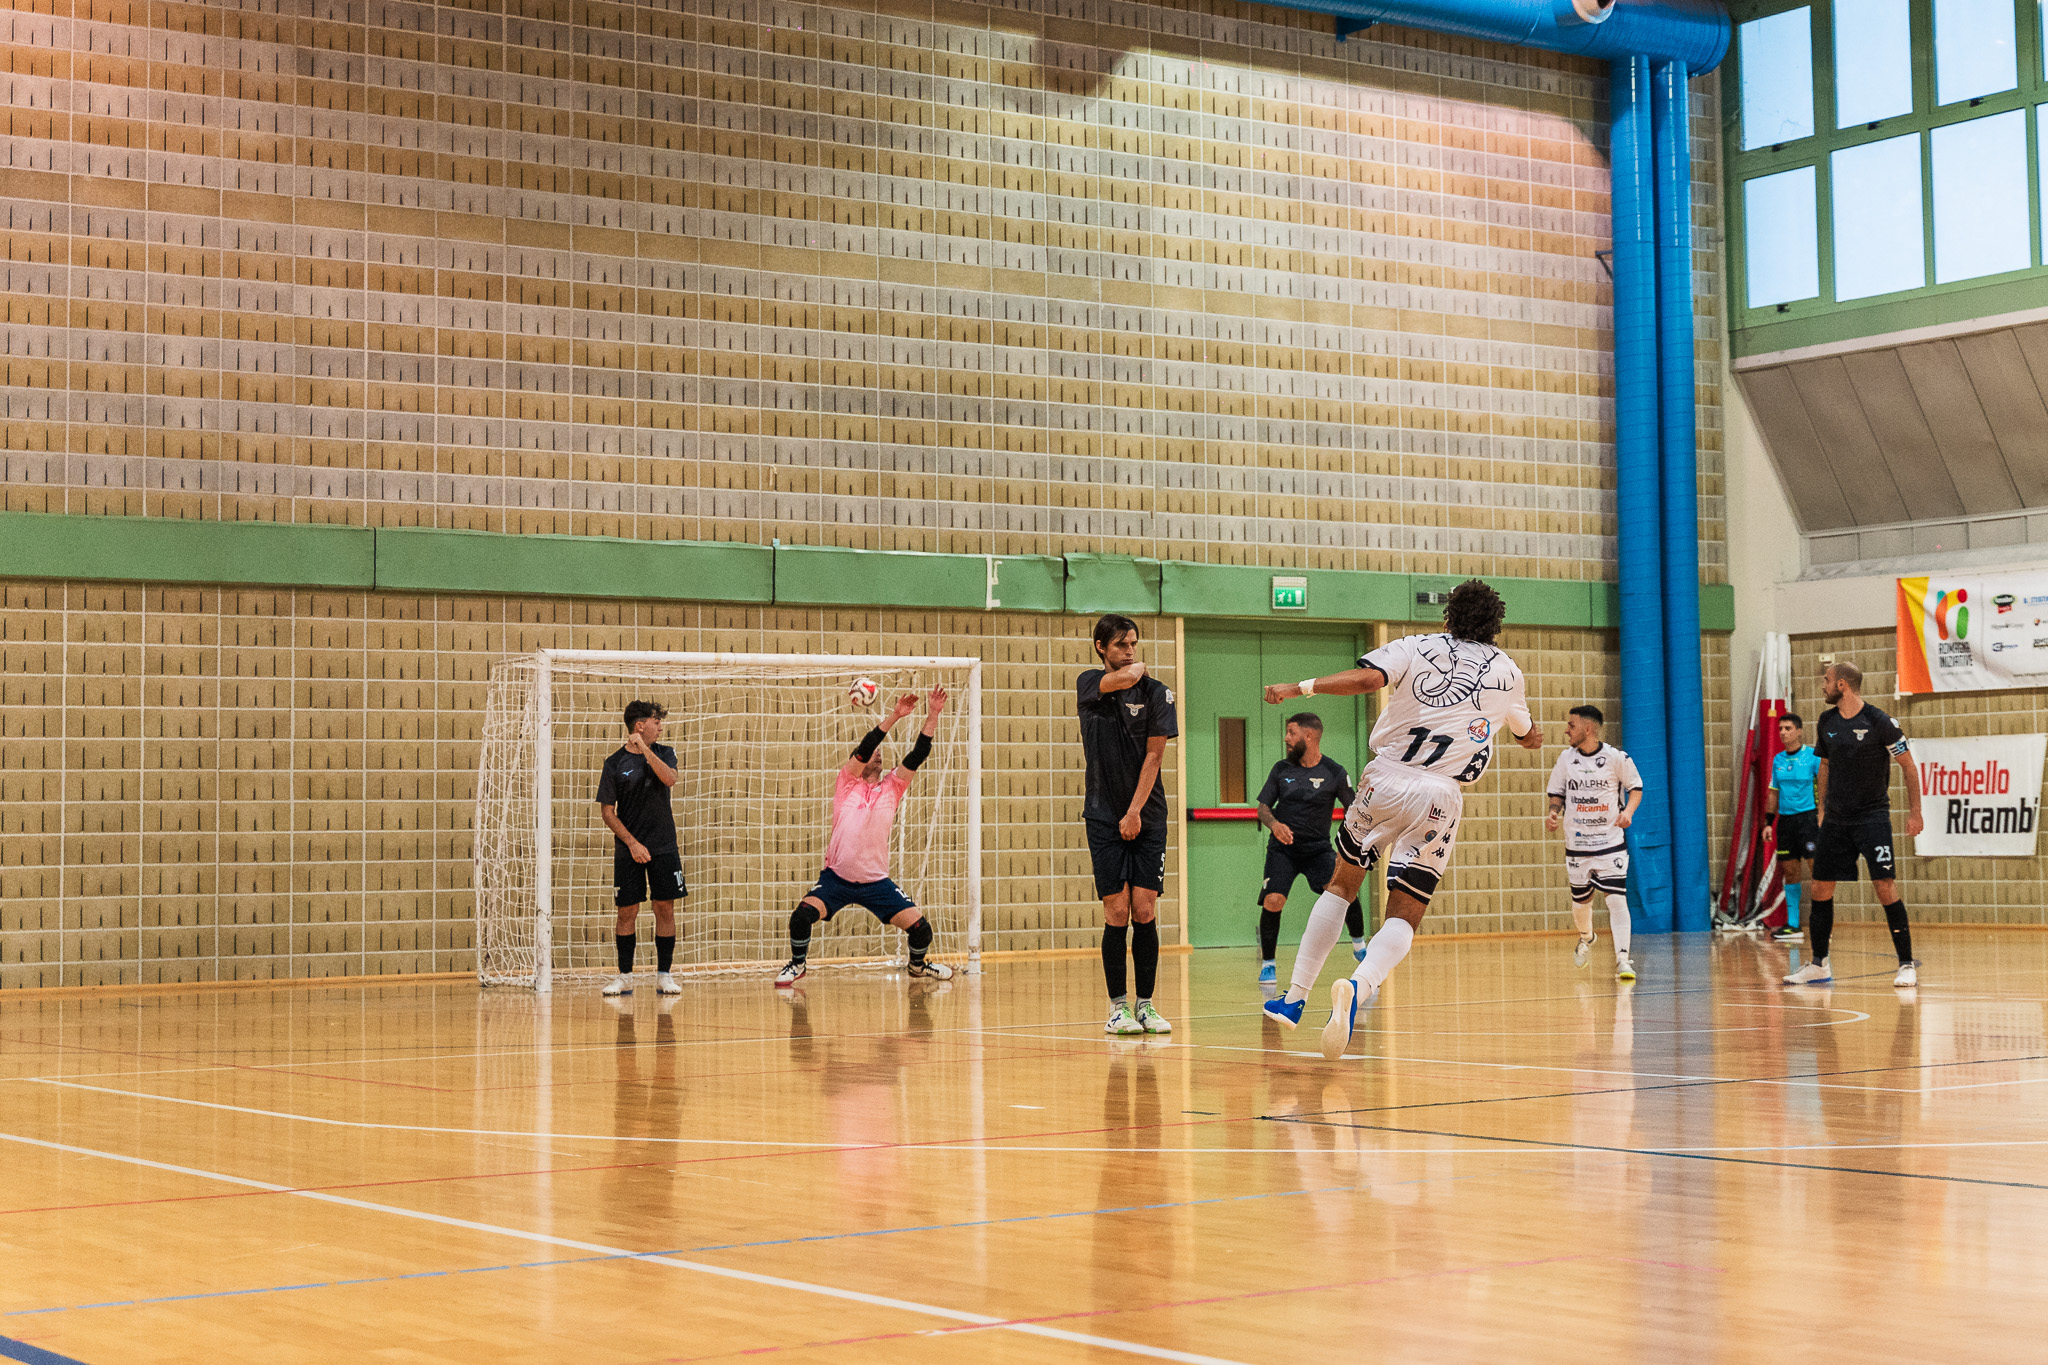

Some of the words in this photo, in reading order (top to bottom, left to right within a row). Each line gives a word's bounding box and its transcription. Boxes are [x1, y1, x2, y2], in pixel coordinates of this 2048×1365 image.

[1400, 726, 1454, 768] 11
[1579, 779, 1610, 788] ALPHA
[1920, 760, 2010, 796] Vitobello
[1576, 803, 1609, 812] Ricambi
[1946, 796, 2039, 834] Ricambi
[1874, 845, 1892, 862] 23
